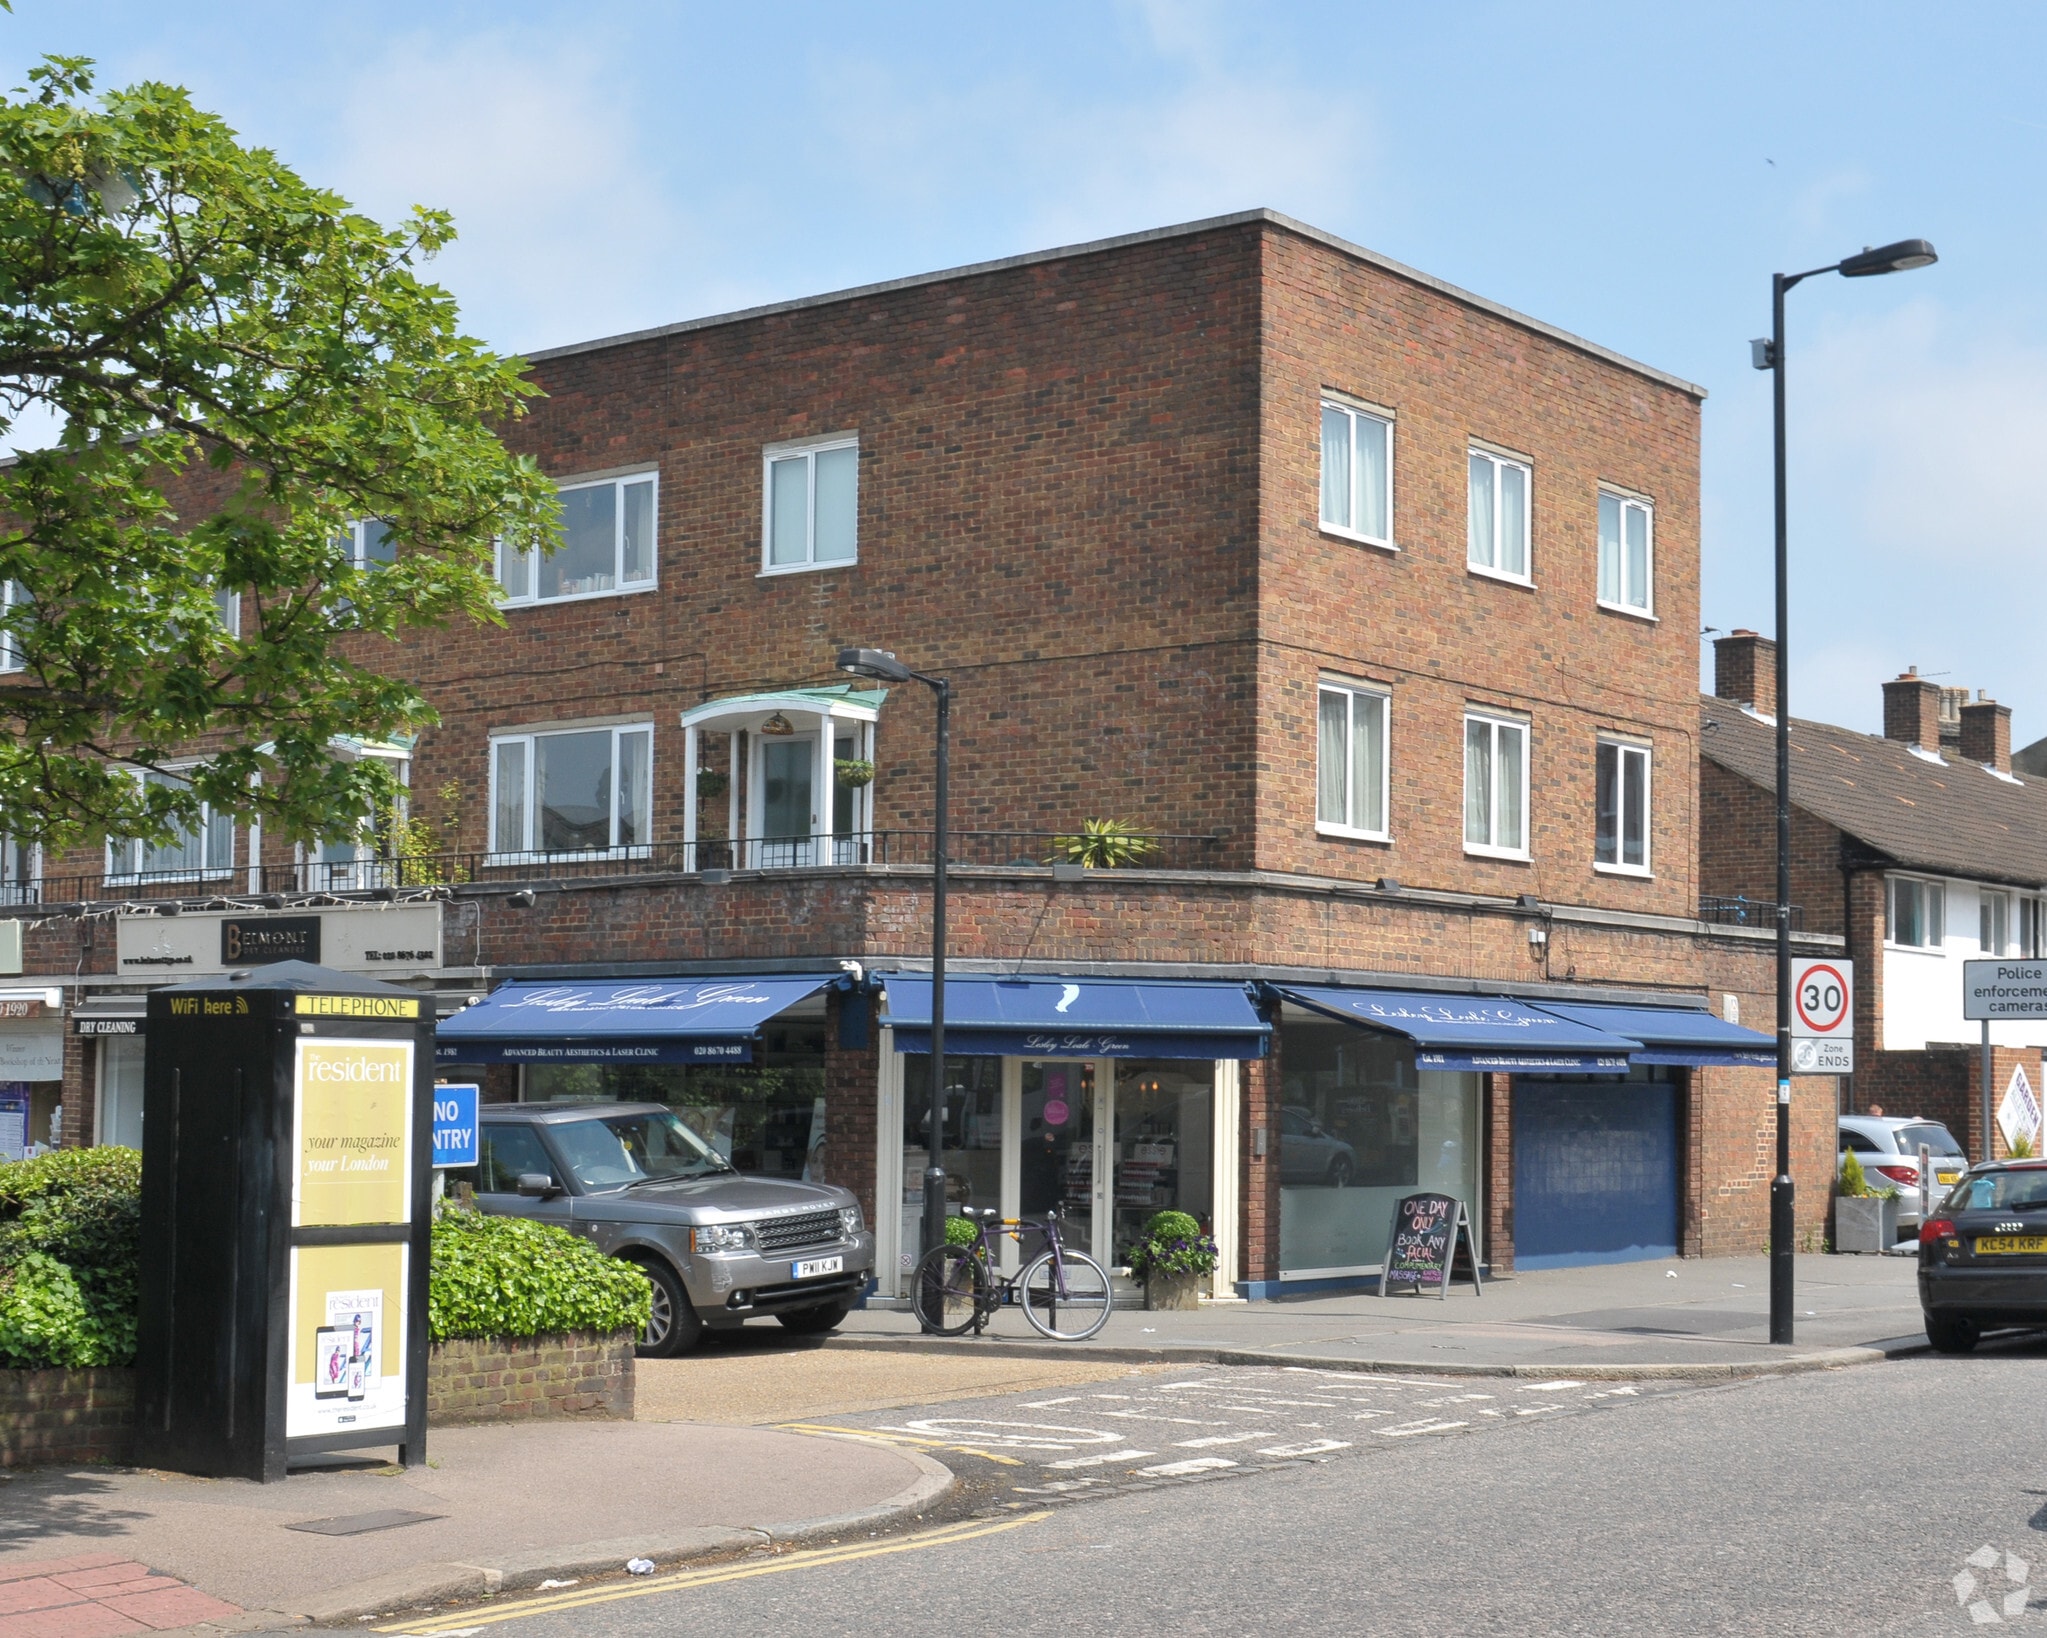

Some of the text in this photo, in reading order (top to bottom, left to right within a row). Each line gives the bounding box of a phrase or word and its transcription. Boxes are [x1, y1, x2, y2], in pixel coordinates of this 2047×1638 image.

[227, 924, 307, 960] BELMONT
[1997, 966, 2042, 980] Police
[170, 997, 232, 1015] WiFi here
[308, 996, 408, 1016] TELEPHONE
[1804, 984, 1841, 1012] 30
[6, 1002, 28, 1016] 1920
[79, 1021, 136, 1033] DRY CLEANING
[502, 1047, 659, 1056] ADVANCED BEAUTY AESTHETICS & LASER CLINIC
[694, 1046, 742, 1055] 020 8670 4488
[1023, 1034, 1058, 1053] Lesley
[1098, 1035, 1130, 1054] Green
[1823, 1043, 1844, 1053] Zone
[308, 1056, 401, 1082] resident
[1818, 1055, 1850, 1067] ENDS
[2016, 1072, 2039, 1128] GARDEN
[433, 1100, 459, 1122] NO
[305, 1132, 401, 1153] your magazine
[304, 1154, 389, 1176] your London
[801, 1201, 837, 1211] ROVER
[1404, 1200, 1448, 1218] ONE DAY
[1412, 1215, 1434, 1230] ONLY
[1981, 1237, 2044, 1251] KC54 KRF
[821, 1261, 838, 1272] KJW
